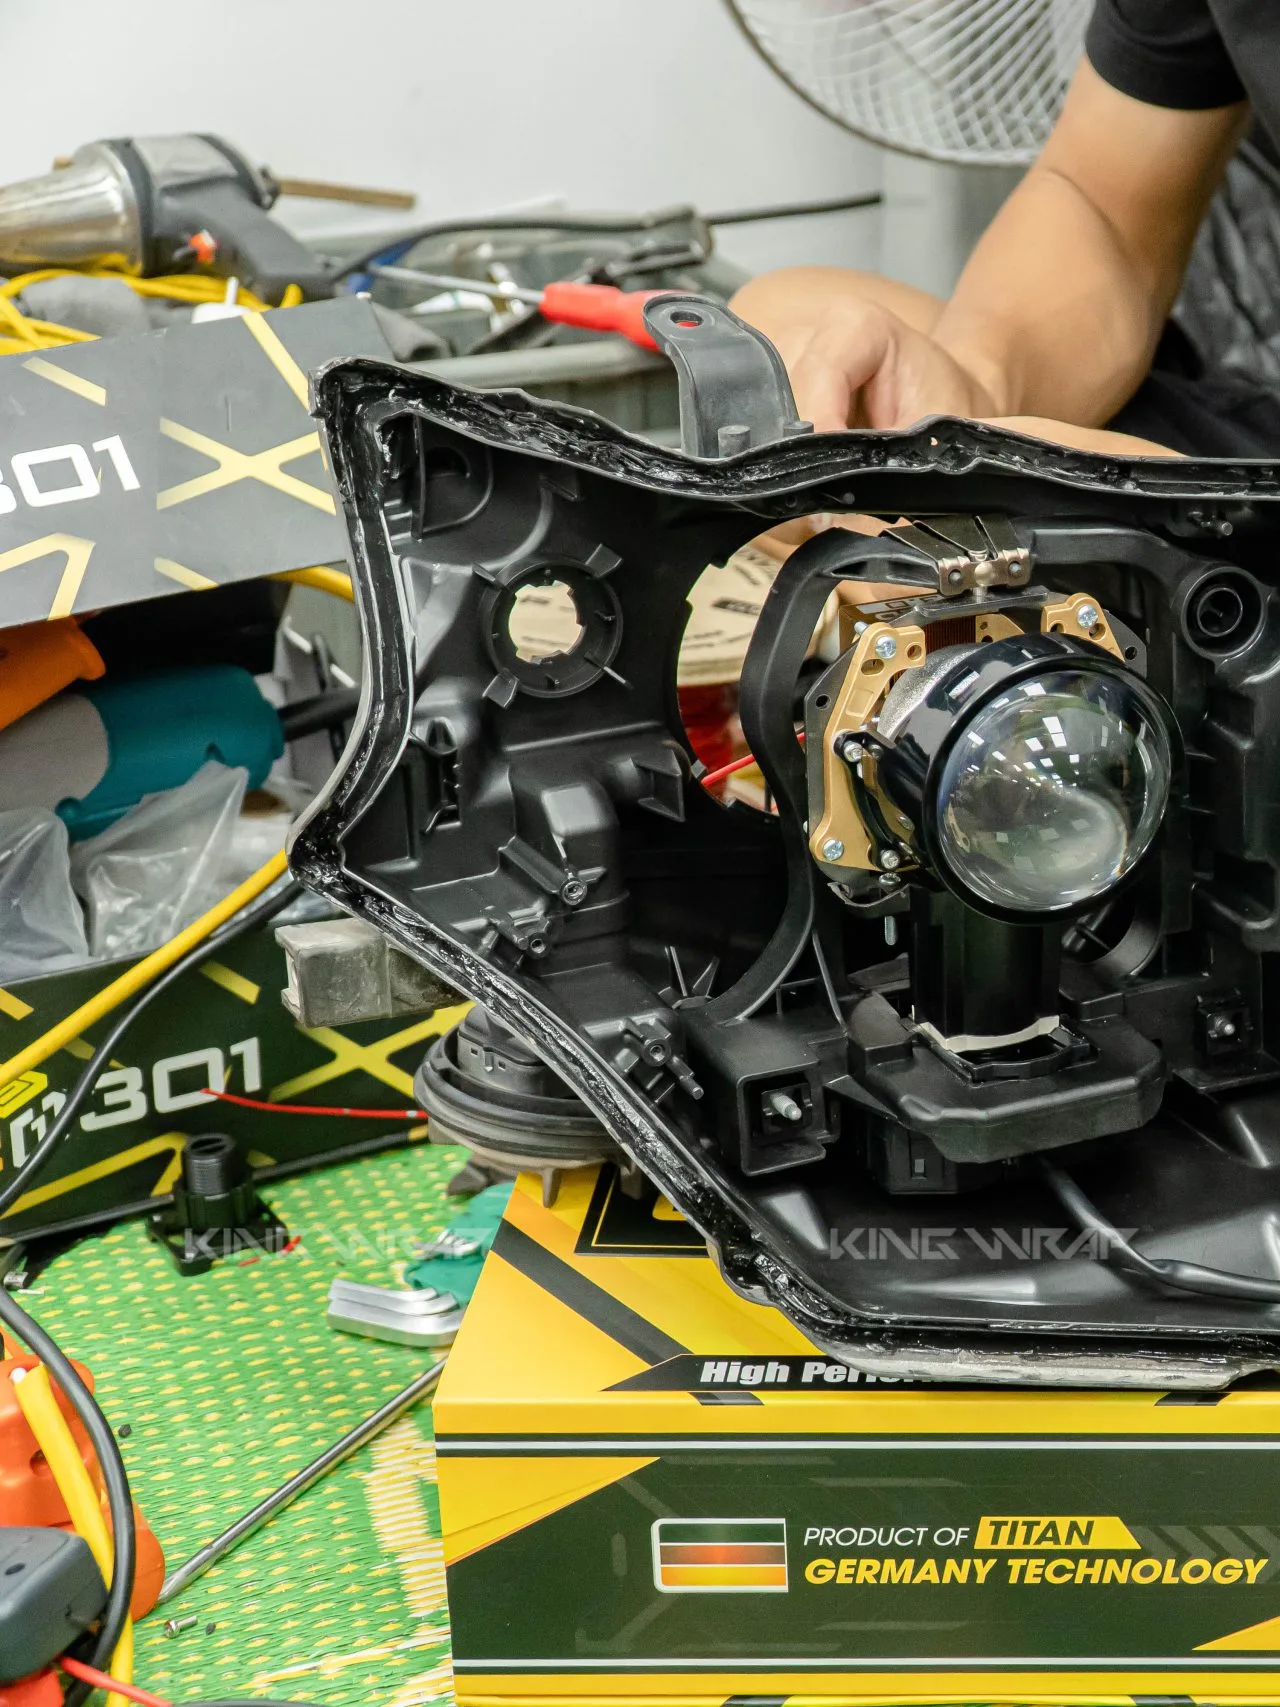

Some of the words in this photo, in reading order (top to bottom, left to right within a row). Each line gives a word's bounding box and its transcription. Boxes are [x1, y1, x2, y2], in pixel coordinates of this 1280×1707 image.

[79, 1036, 261, 1132] 301
[700, 1361, 789, 1385] High
[804, 1528, 928, 1546] PRODUCT
[934, 1528, 970, 1546] OF
[989, 1520, 1094, 1546] TITAN
[805, 1558, 997, 1585] GERMANY
[1008, 1558, 1268, 1585] TECHNOLOGY
